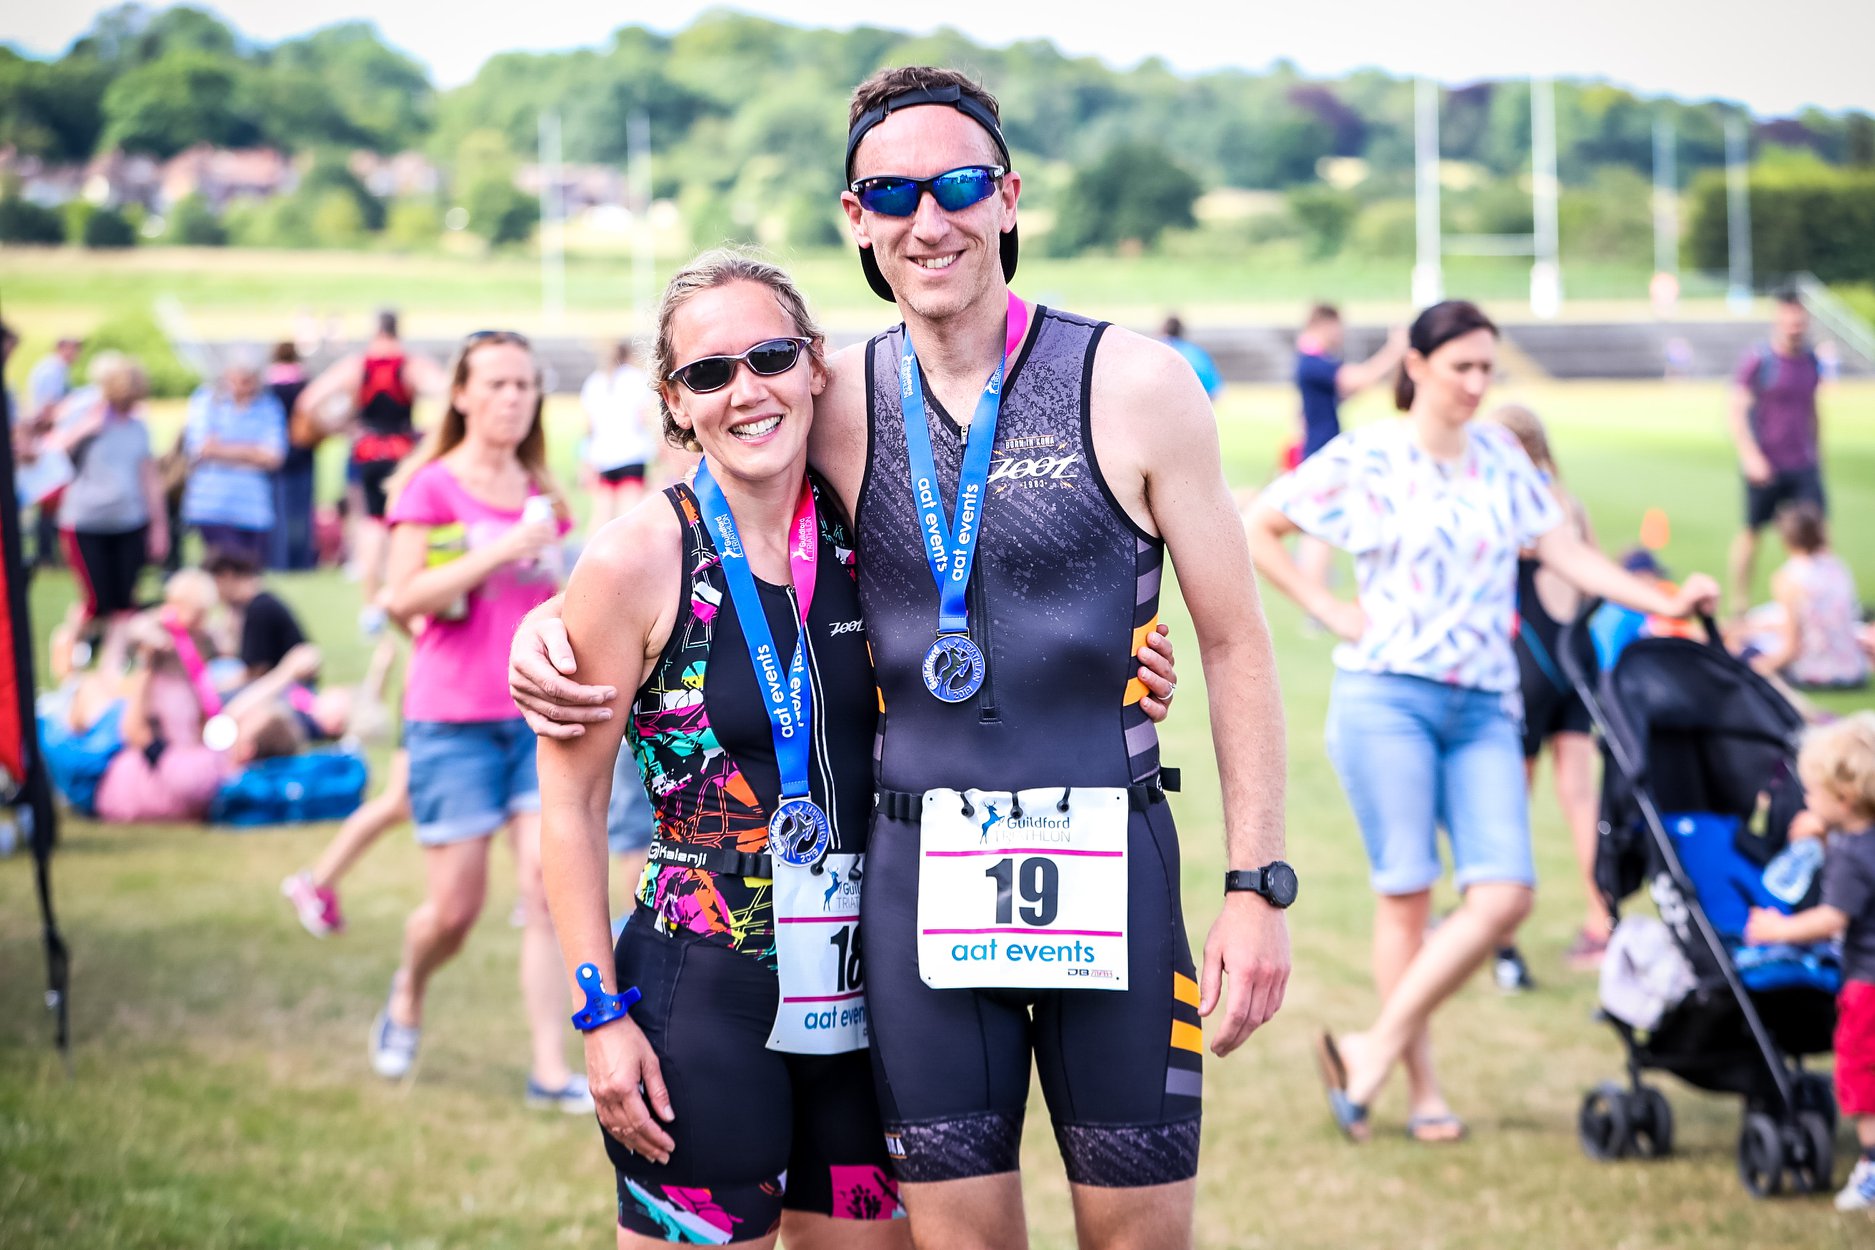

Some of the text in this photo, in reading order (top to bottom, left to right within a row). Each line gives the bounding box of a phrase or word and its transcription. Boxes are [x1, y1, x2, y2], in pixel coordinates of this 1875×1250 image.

[1026, 438, 1034, 447] IN
[917, 477, 948, 573] aat events
[951, 483, 979, 582] aat events
[756, 644, 795, 738] aat events
[1007, 816, 1070, 829] Guildford
[659, 845, 708, 868] Kalenji
[985, 856, 1059, 927] 19
[951, 938, 1095, 963] aat events
[804, 1005, 866, 1029] aat even
